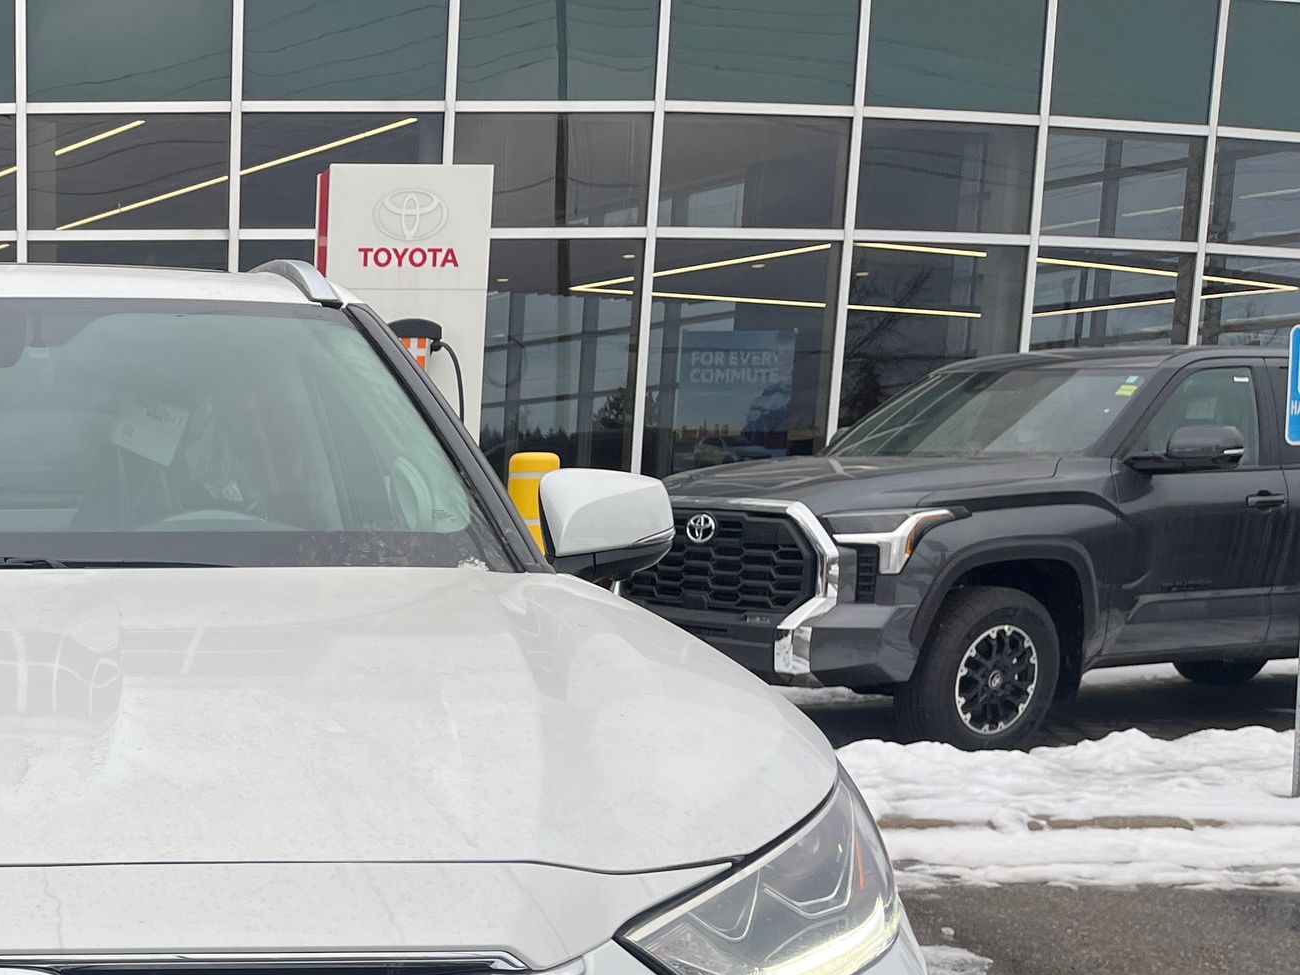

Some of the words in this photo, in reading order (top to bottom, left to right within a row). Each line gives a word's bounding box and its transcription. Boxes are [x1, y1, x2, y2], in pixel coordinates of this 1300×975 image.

[358, 247, 459, 267] TOYOTA
[690, 351, 725, 366] FOR
[689, 368, 778, 384] COMMUTE
